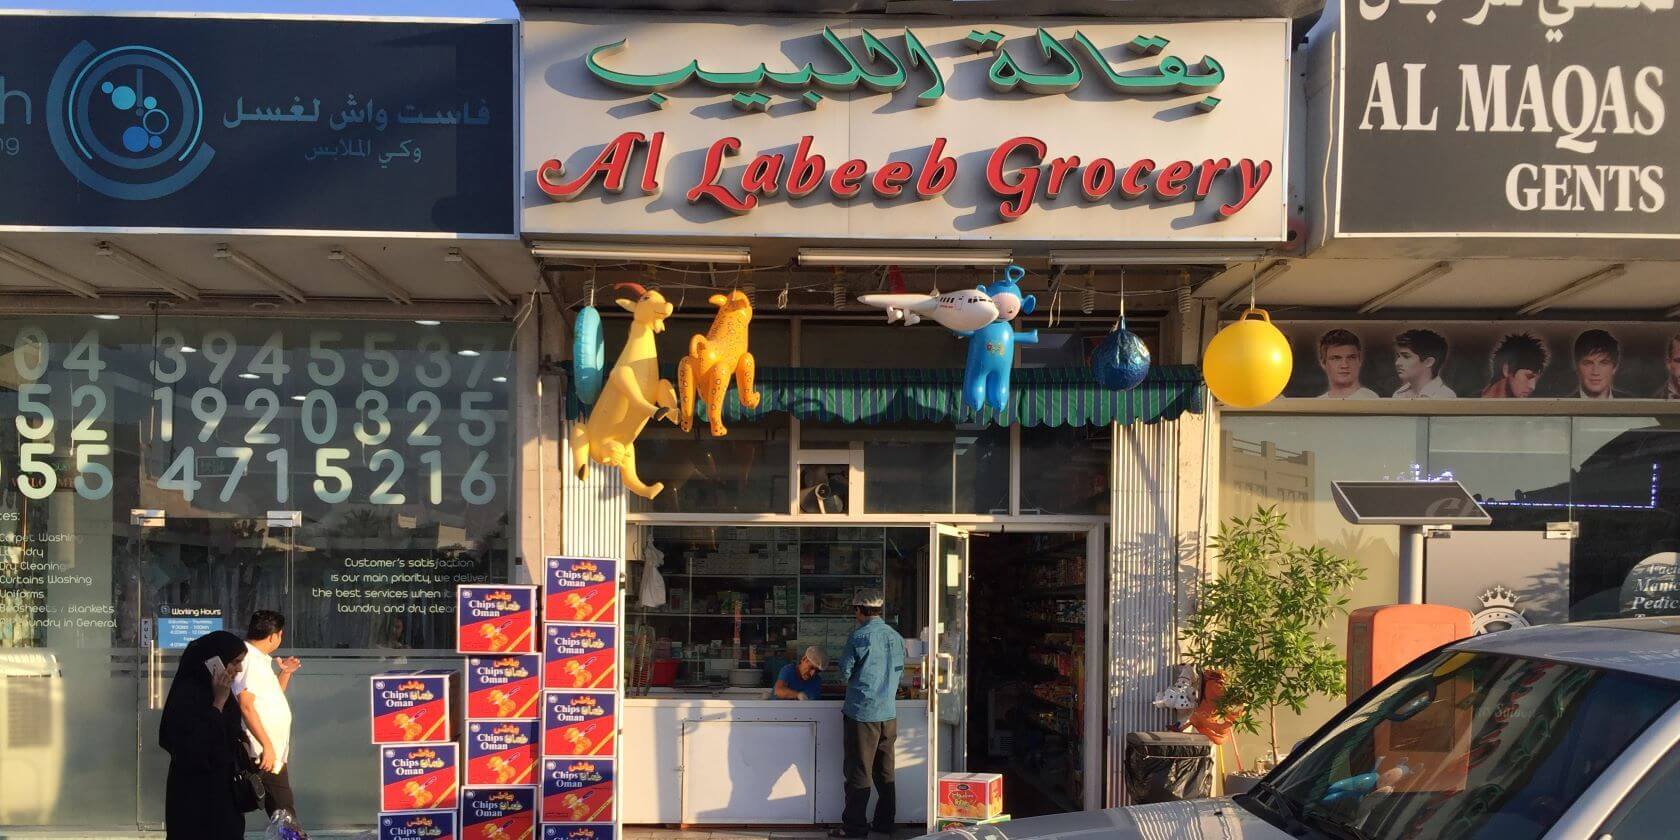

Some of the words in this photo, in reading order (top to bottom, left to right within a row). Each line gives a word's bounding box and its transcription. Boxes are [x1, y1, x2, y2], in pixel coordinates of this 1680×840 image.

[586, 25, 944, 109] اللبيب
[223, 96, 320, 128] لغسل
[330, 94, 387, 131] واش
[399, 98, 490, 124] فاست
[1359, 62, 1438, 131] AL
[1456, 64, 1665, 153] MAQAS
[305, 138, 371, 160] الملابس
[379, 139, 421, 168] وكي
[537, 131, 665, 200] Al
[687, 134, 957, 214] Labeeb
[986, 136, 1272, 220] Grocery
[1505, 163, 1665, 212] GENTS
[14, 327, 107, 382] 04
[150, 328, 495, 388] 3945537
[15, 384, 107, 439] 52
[154, 386, 496, 446] 1920325
[157, 446, 496, 505] 4715216
[344, 557, 405, 568] Customer's
[408, 558, 474, 569] satisfaction
[331, 573, 339, 582] is
[342, 574, 360, 582] our
[363, 573, 388, 582] main
[454, 573, 488, 582] deliver
[555, 570, 581, 579] Chips
[0, 576, 44, 584] Curtains
[48, 575, 93, 586] Washing
[559, 578, 586, 587] Oman
[0, 588, 45, 599] Uniforms
[312, 588, 332, 598] the
[336, 588, 361, 598] best
[365, 589, 408, 598] services
[411, 588, 441, 598] when
[68, 604, 115, 613] Blankets
[338, 603, 381, 615] laundry
[384, 603, 405, 613] and
[408, 603, 427, 615] dry
[468, 600, 495, 610] Chips
[171, 608, 200, 616] Working
[472, 608, 500, 617] Oman
[77, 618, 117, 628] General
[555, 637, 580, 647] Chips
[557, 646, 585, 654] Oman
[477, 667, 503, 676] Chips
[480, 676, 508, 684] Oman
[382, 691, 408, 700] Chips
[386, 699, 414, 707] Oman
[554, 704, 580, 714] Chips
[557, 713, 584, 721] Oman
[477, 733, 503, 743] Chips
[480, 742, 508, 750] Oman
[392, 758, 419, 768] Chips
[395, 767, 424, 775] Oman
[552, 771, 579, 781] Chips
[556, 779, 583, 788] Oman
[472, 800, 498, 810] Chips
[475, 809, 502, 817] Oman
[389, 827, 417, 836] Chips
